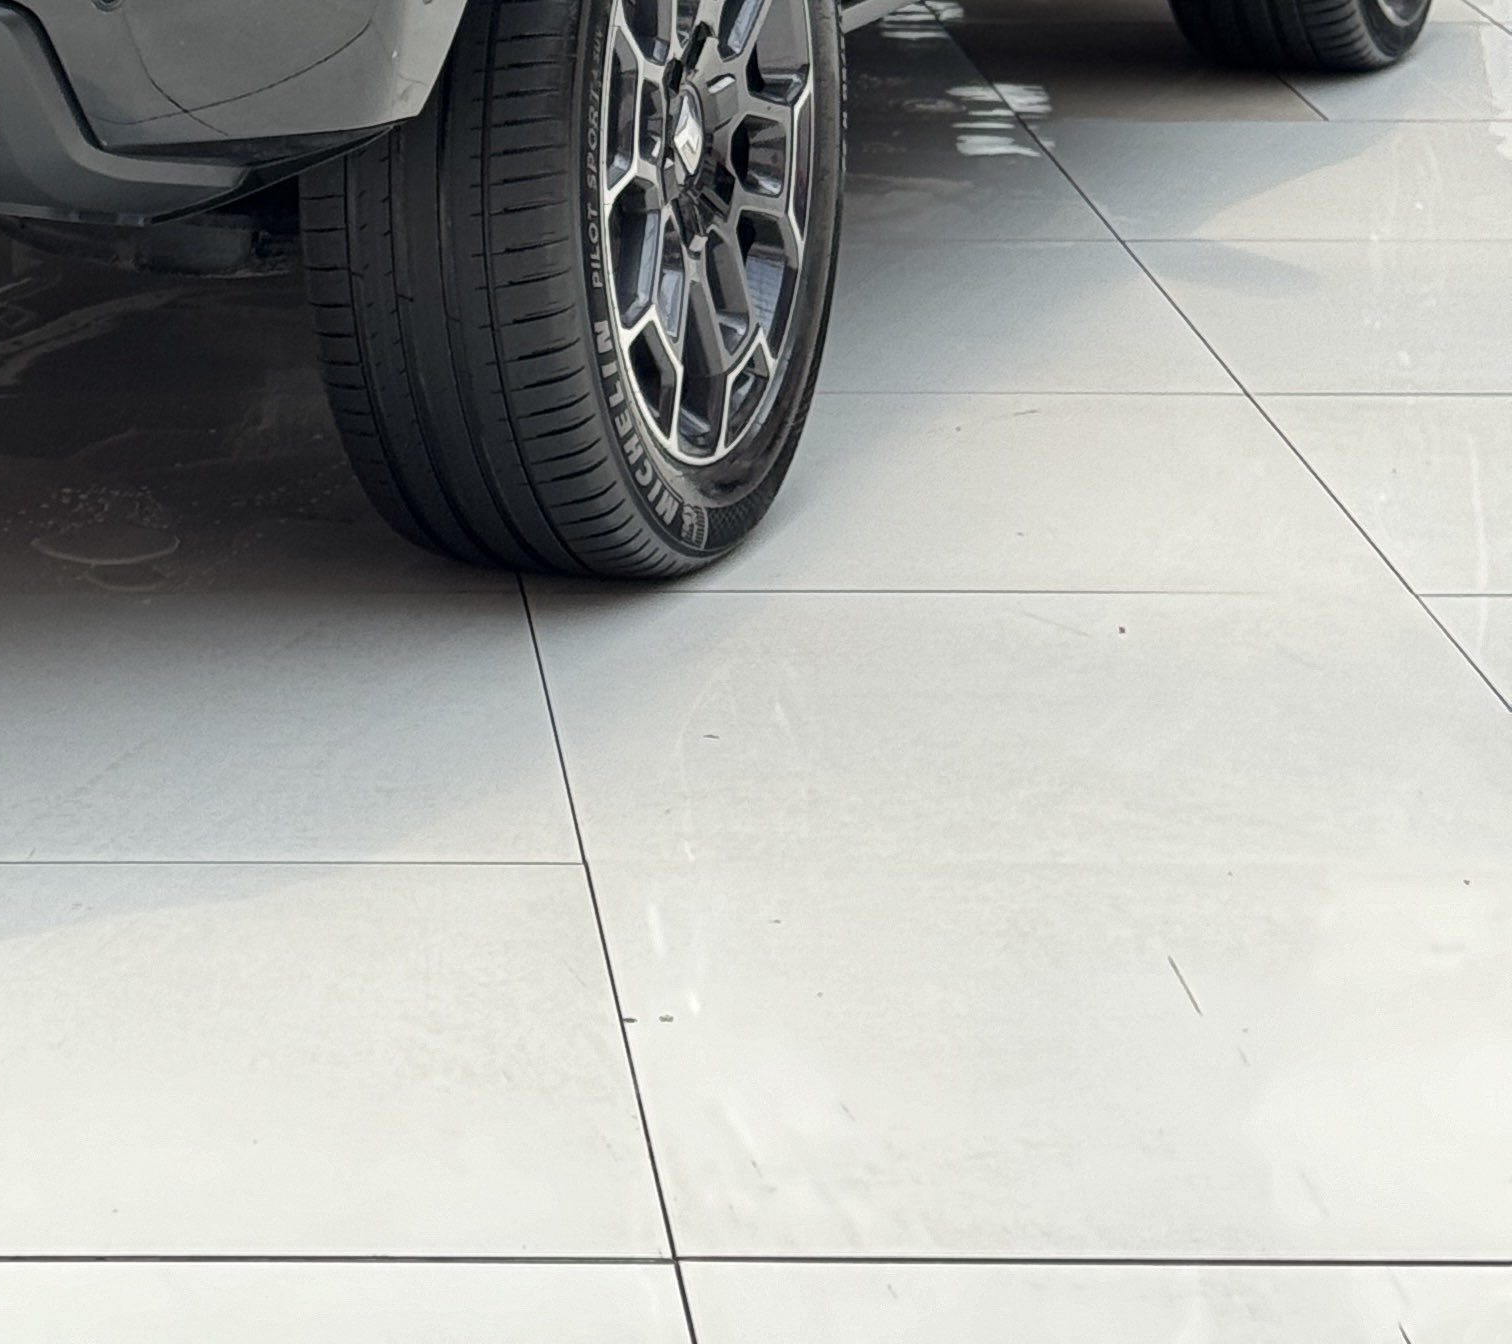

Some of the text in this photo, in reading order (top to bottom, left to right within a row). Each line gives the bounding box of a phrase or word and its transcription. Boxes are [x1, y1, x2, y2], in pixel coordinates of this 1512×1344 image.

[586, 89, 600, 190] SPORT
[585, 201, 604, 289] PILOT
[593, 318, 679, 526] MICHELIN
